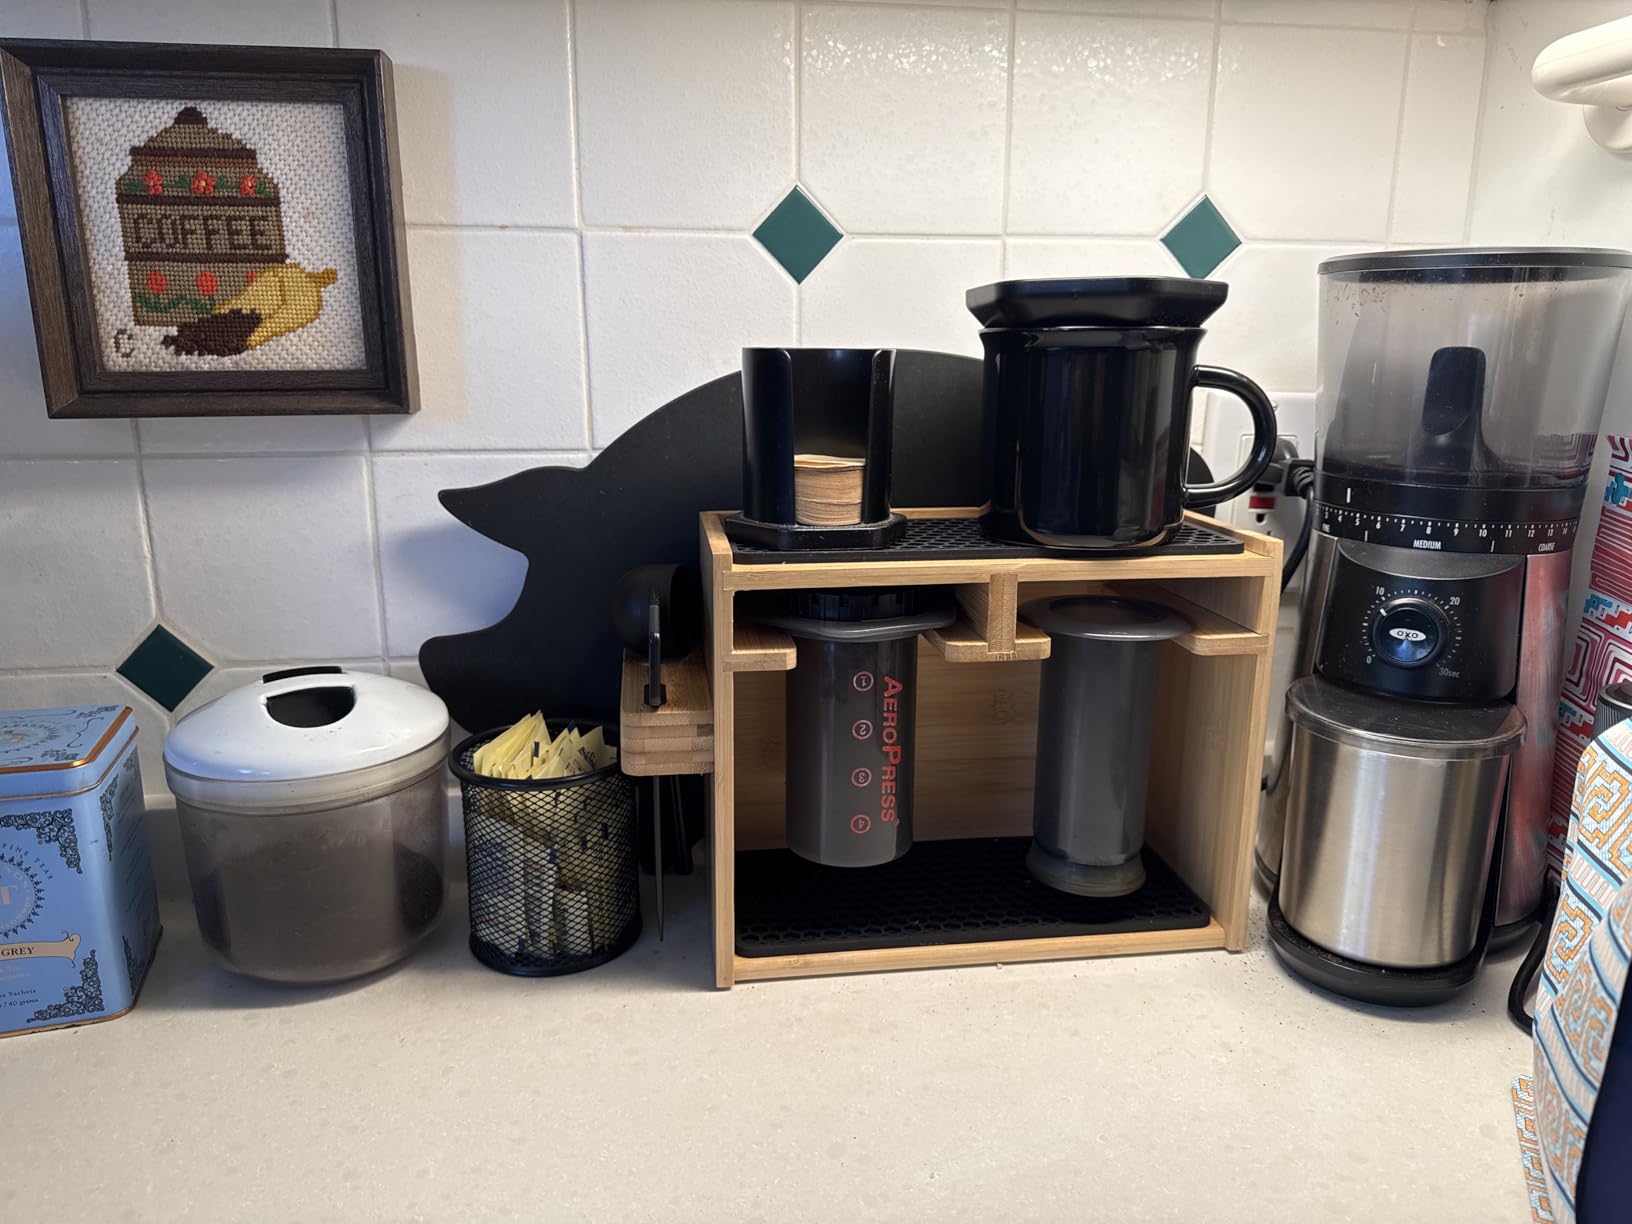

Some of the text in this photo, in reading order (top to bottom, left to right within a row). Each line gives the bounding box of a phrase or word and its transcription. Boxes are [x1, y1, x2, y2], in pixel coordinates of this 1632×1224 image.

[133, 212, 273, 251] COFFEE
[1354, 518, 1360, 526] 5
[1375, 521, 1381, 530] 6
[1400, 524, 1406, 532] 7
[1425, 526, 1432, 535] 8
[1453, 528, 1459, 537] 9
[1479, 529, 1488, 537] 10
[1505, 529, 1513, 538] 11
[1527, 529, 1535, 538] 12
[1547, 528, 1554, 537] 13
[1413, 539, 1442, 550] MEDIUM
[1538, 542, 1556, 552] COARSE
[1375, 586, 1385, 596] 10
[1449, 596, 1460, 606] 20
[1396, 630, 1419, 640] OXO
[1366, 655, 1372, 664] 0
[1, 946, 35, 957] GREY
